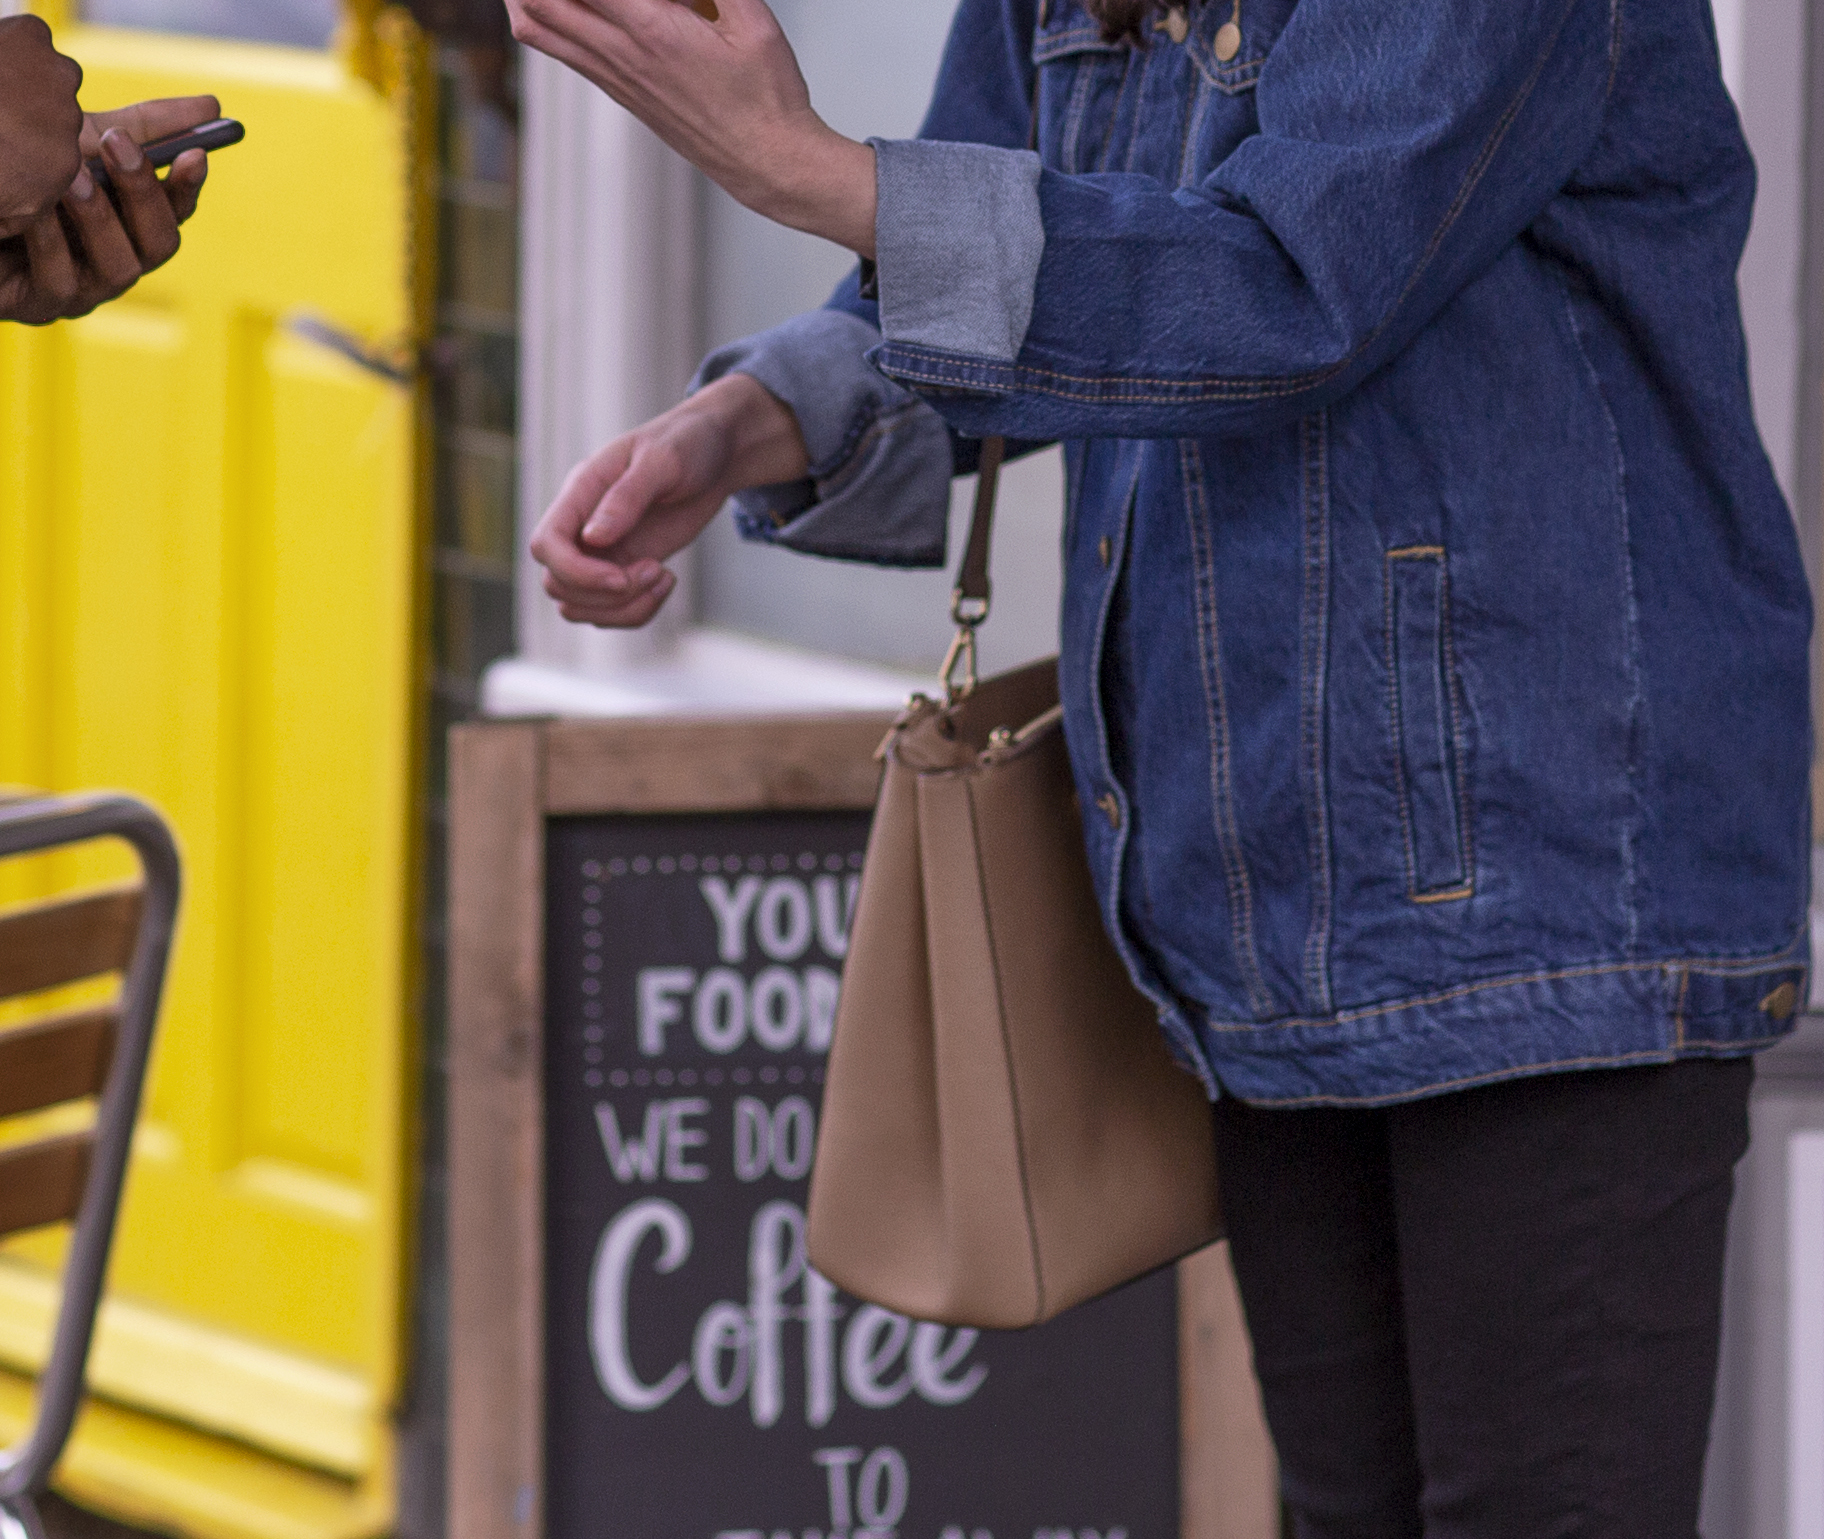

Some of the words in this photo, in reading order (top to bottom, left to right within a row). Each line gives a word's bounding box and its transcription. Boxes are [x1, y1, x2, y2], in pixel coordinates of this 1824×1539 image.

[593, 1097, 710, 1183] WE
[732, 1095, 816, 1182] DO
[587, 1196, 990, 1429] Coffee
[811, 1445, 910, 1530] TO
